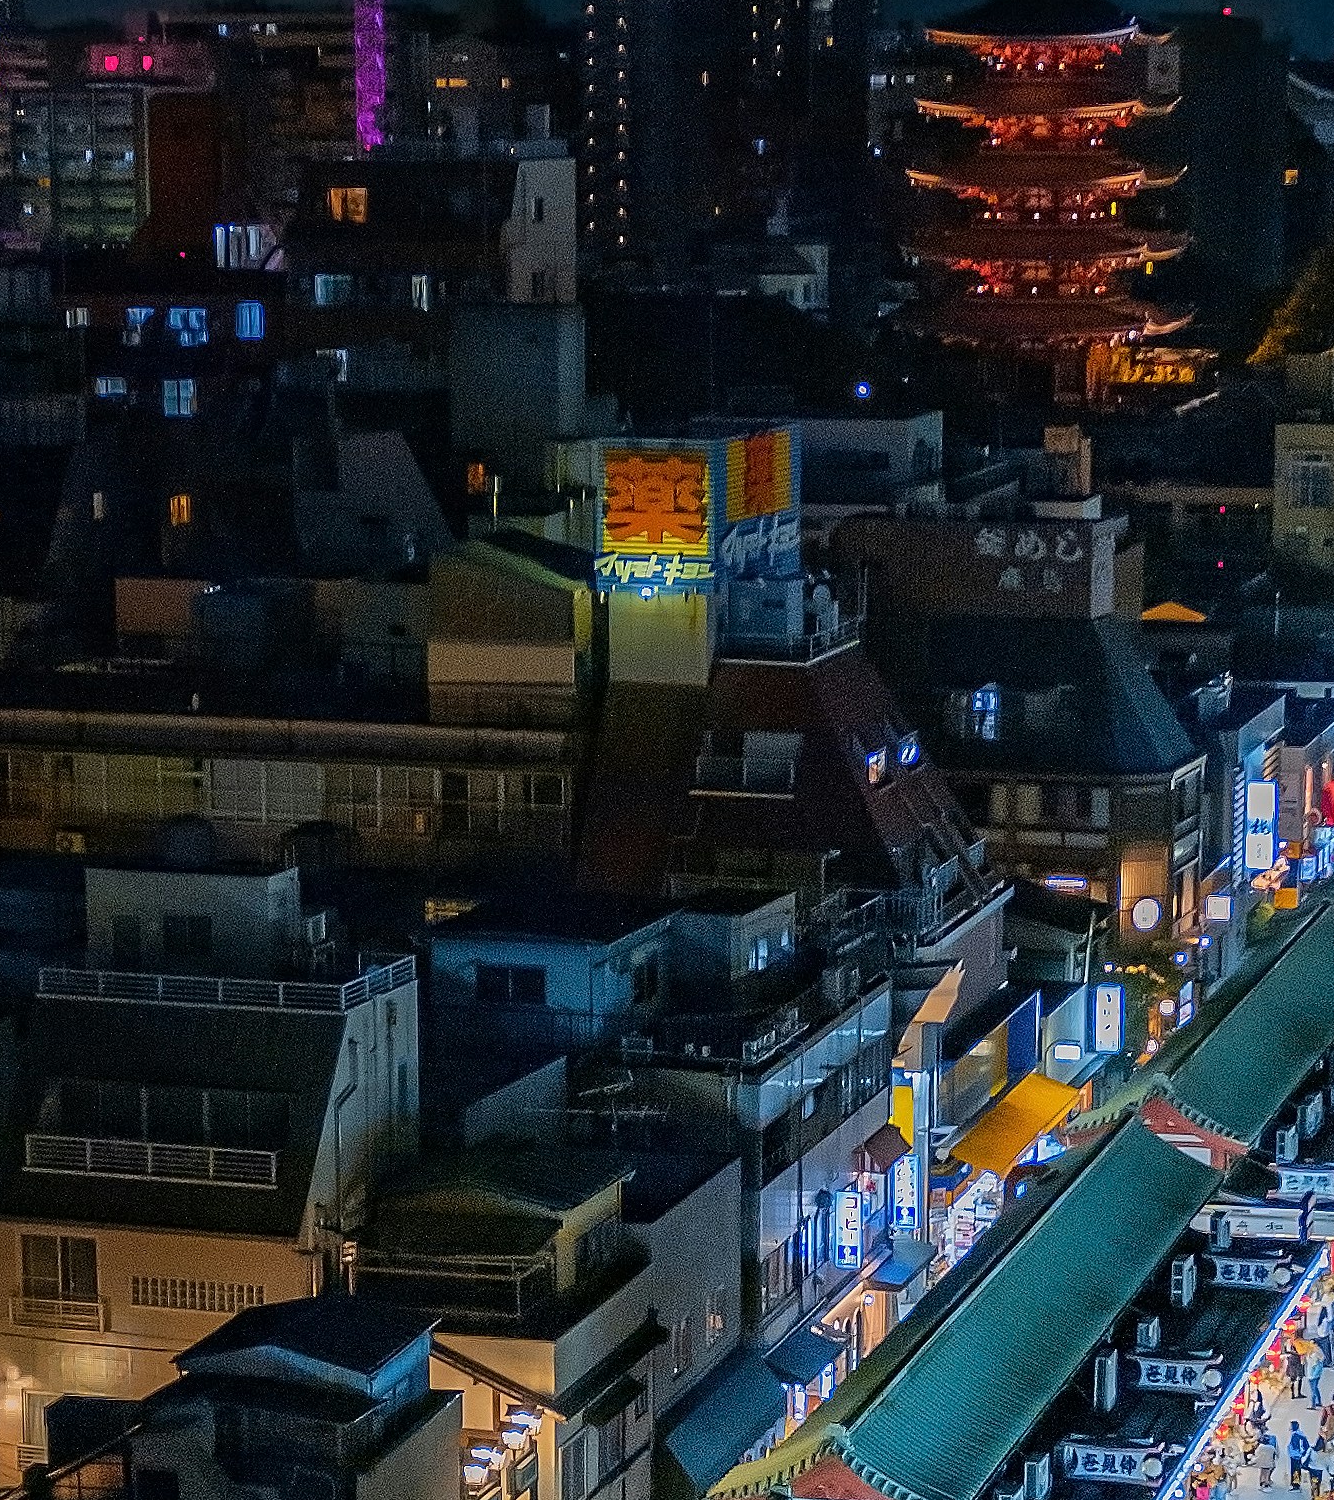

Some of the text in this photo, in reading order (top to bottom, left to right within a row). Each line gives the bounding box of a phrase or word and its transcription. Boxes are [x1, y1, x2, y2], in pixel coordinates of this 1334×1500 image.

[605, 456, 706, 543] 薬
[845, 1196, 858, 1240] コーヒー
